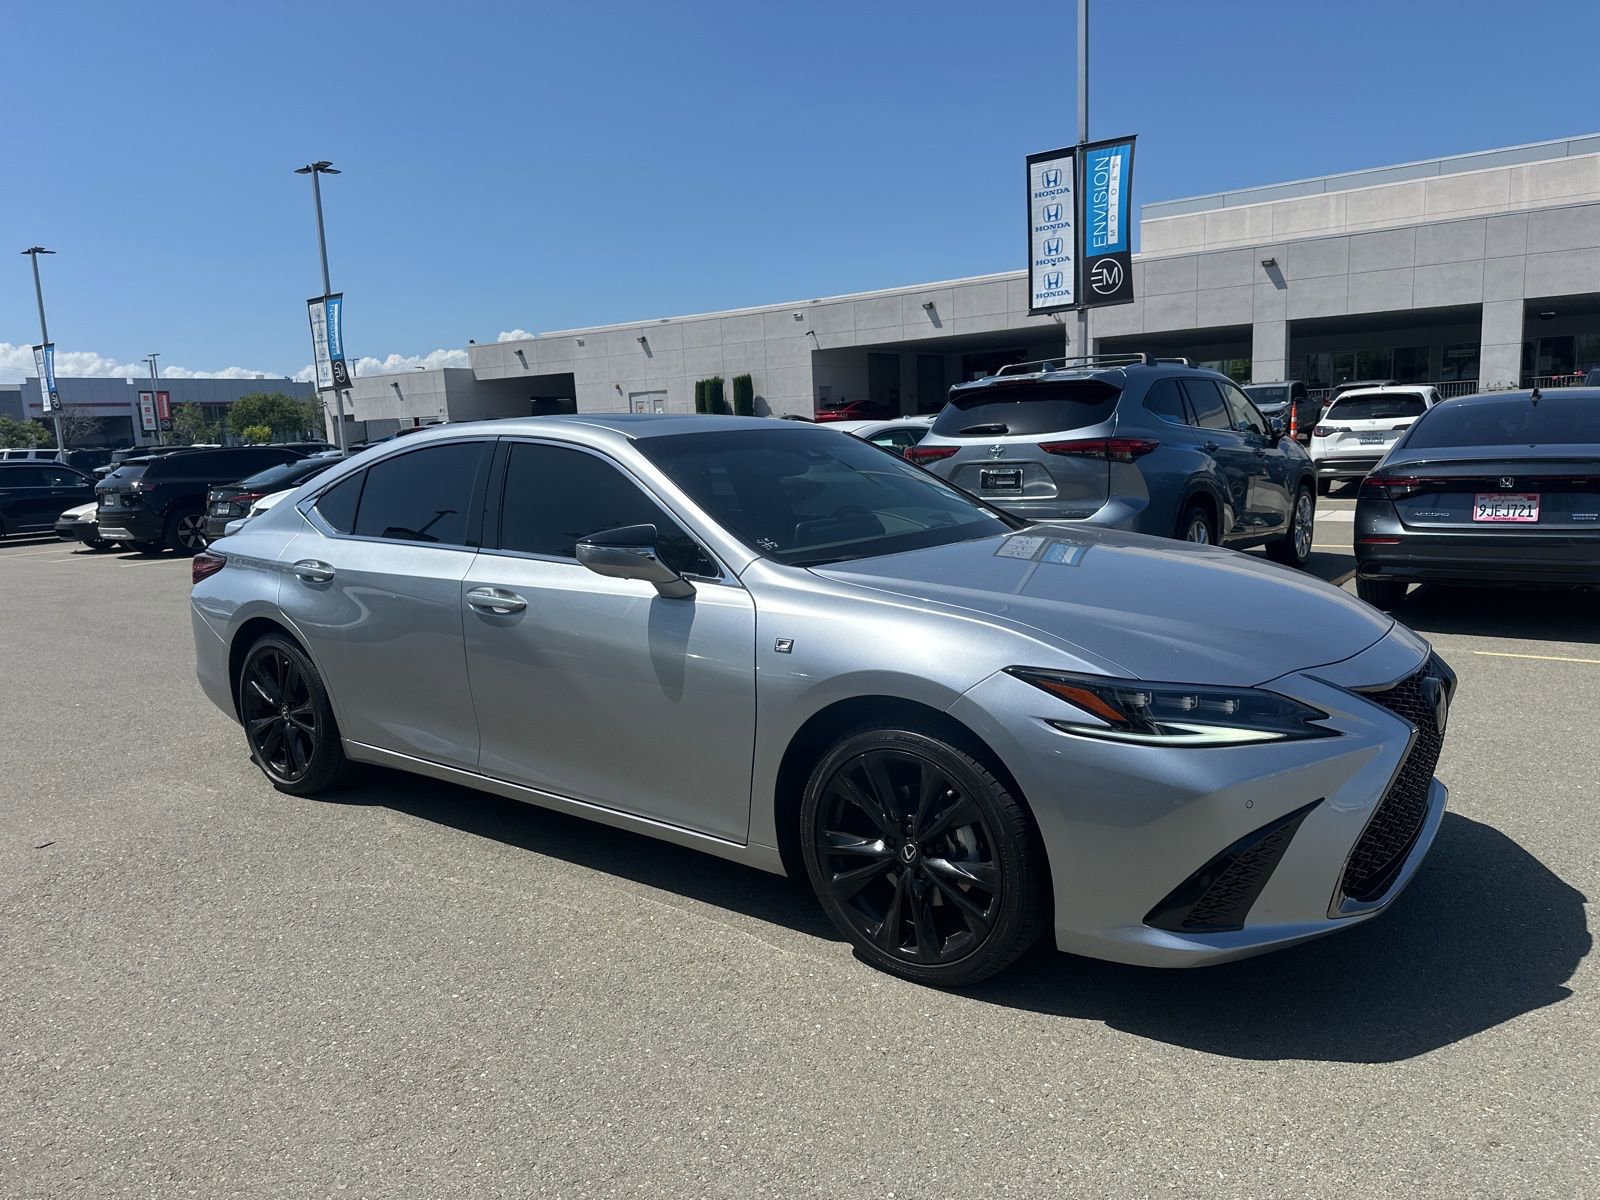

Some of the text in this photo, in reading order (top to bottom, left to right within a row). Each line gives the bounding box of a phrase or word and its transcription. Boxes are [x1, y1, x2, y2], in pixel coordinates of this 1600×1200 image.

[1034, 187, 1071, 199] HONDA
[1110, 161, 1119, 237] MOTORS
[1093, 156, 1110, 248] ENVISION
[1035, 221, 1071, 232] HONDA
[1035, 255, 1071, 266] HONDA
[1035, 289, 1071, 300] HONDA
[1478, 504, 1534, 518] 9JEJ721
